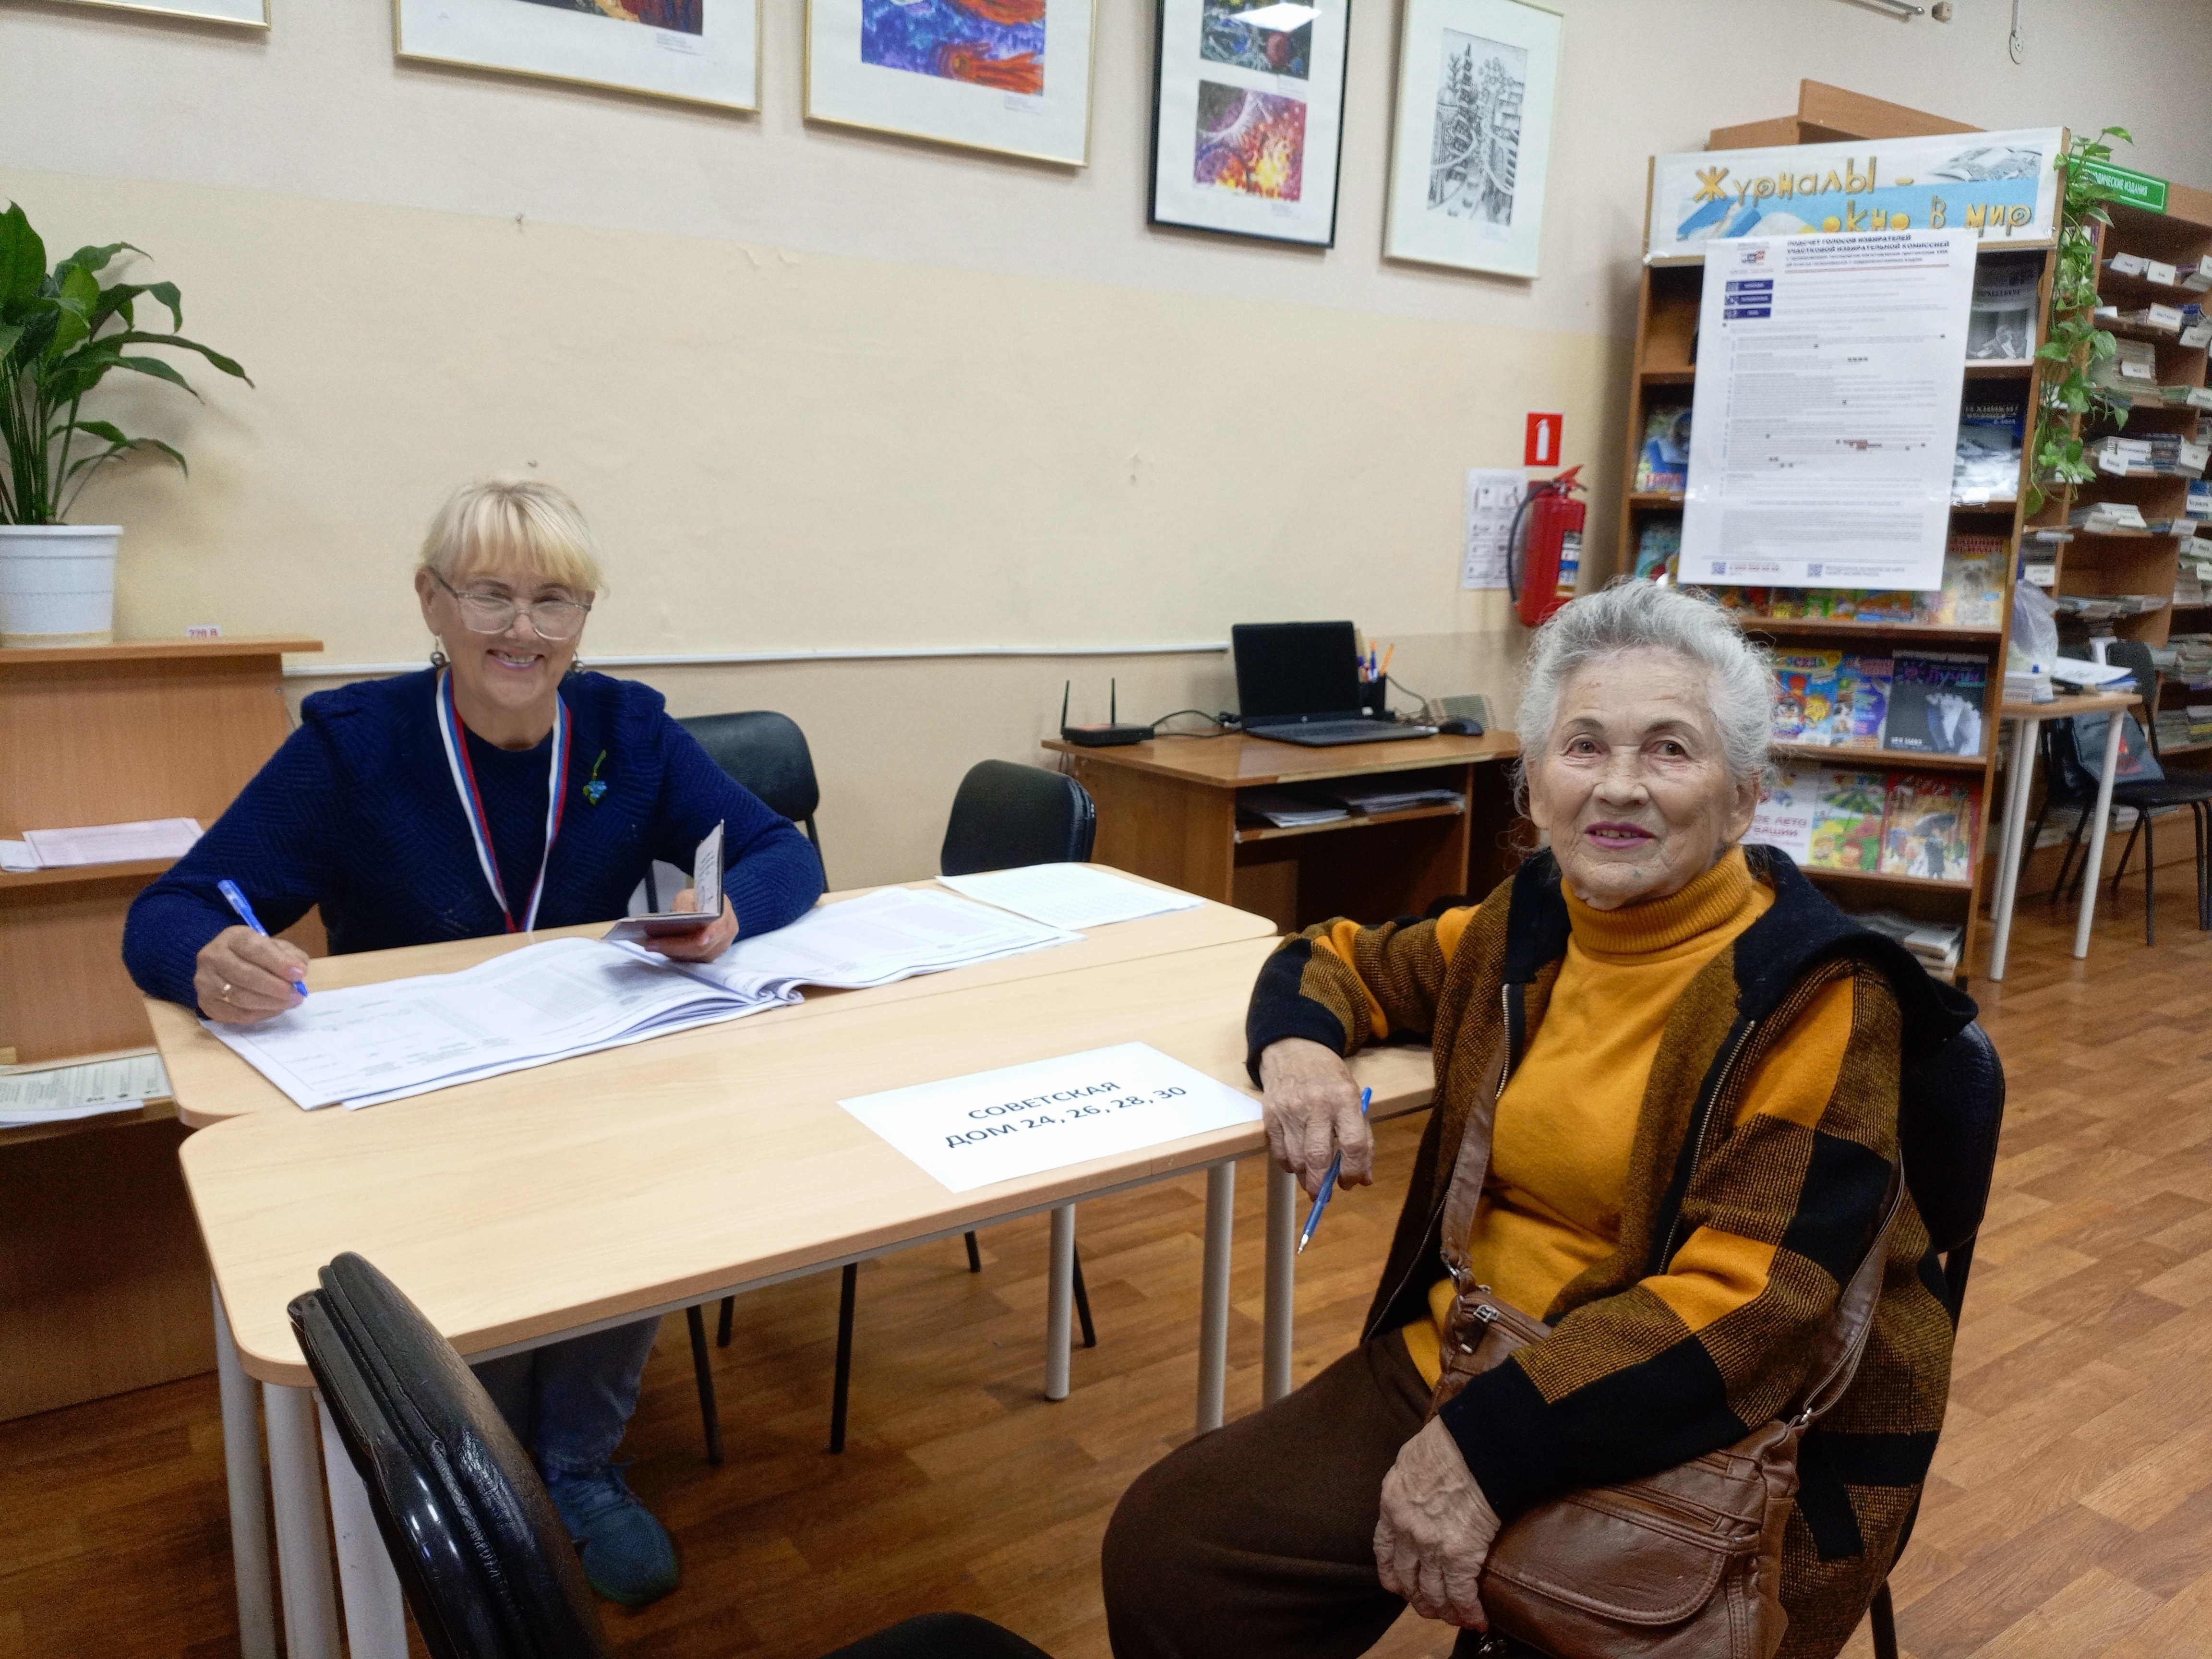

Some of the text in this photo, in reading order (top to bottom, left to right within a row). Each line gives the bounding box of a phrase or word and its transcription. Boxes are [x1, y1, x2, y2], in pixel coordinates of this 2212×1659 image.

[2124, 180, 2148, 196] ИЗДАНИЯ
[1822, 199, 1910, 232] окно
[1966, 203, 2032, 238] мир
[1837, 243, 1900, 251] ИЗБИРАТЕЛЬНОЙ
[1902, 240, 1949, 249] КОМИССИЕЙ
[1858, 233, 1911, 242] ИЗБИРАТЕЛЕЙ
[968, 1082, 1121, 1119] СОВЕТСКАЯ
[945, 1087, 1187, 1149] ДОМ 24, 26, 28, 30
